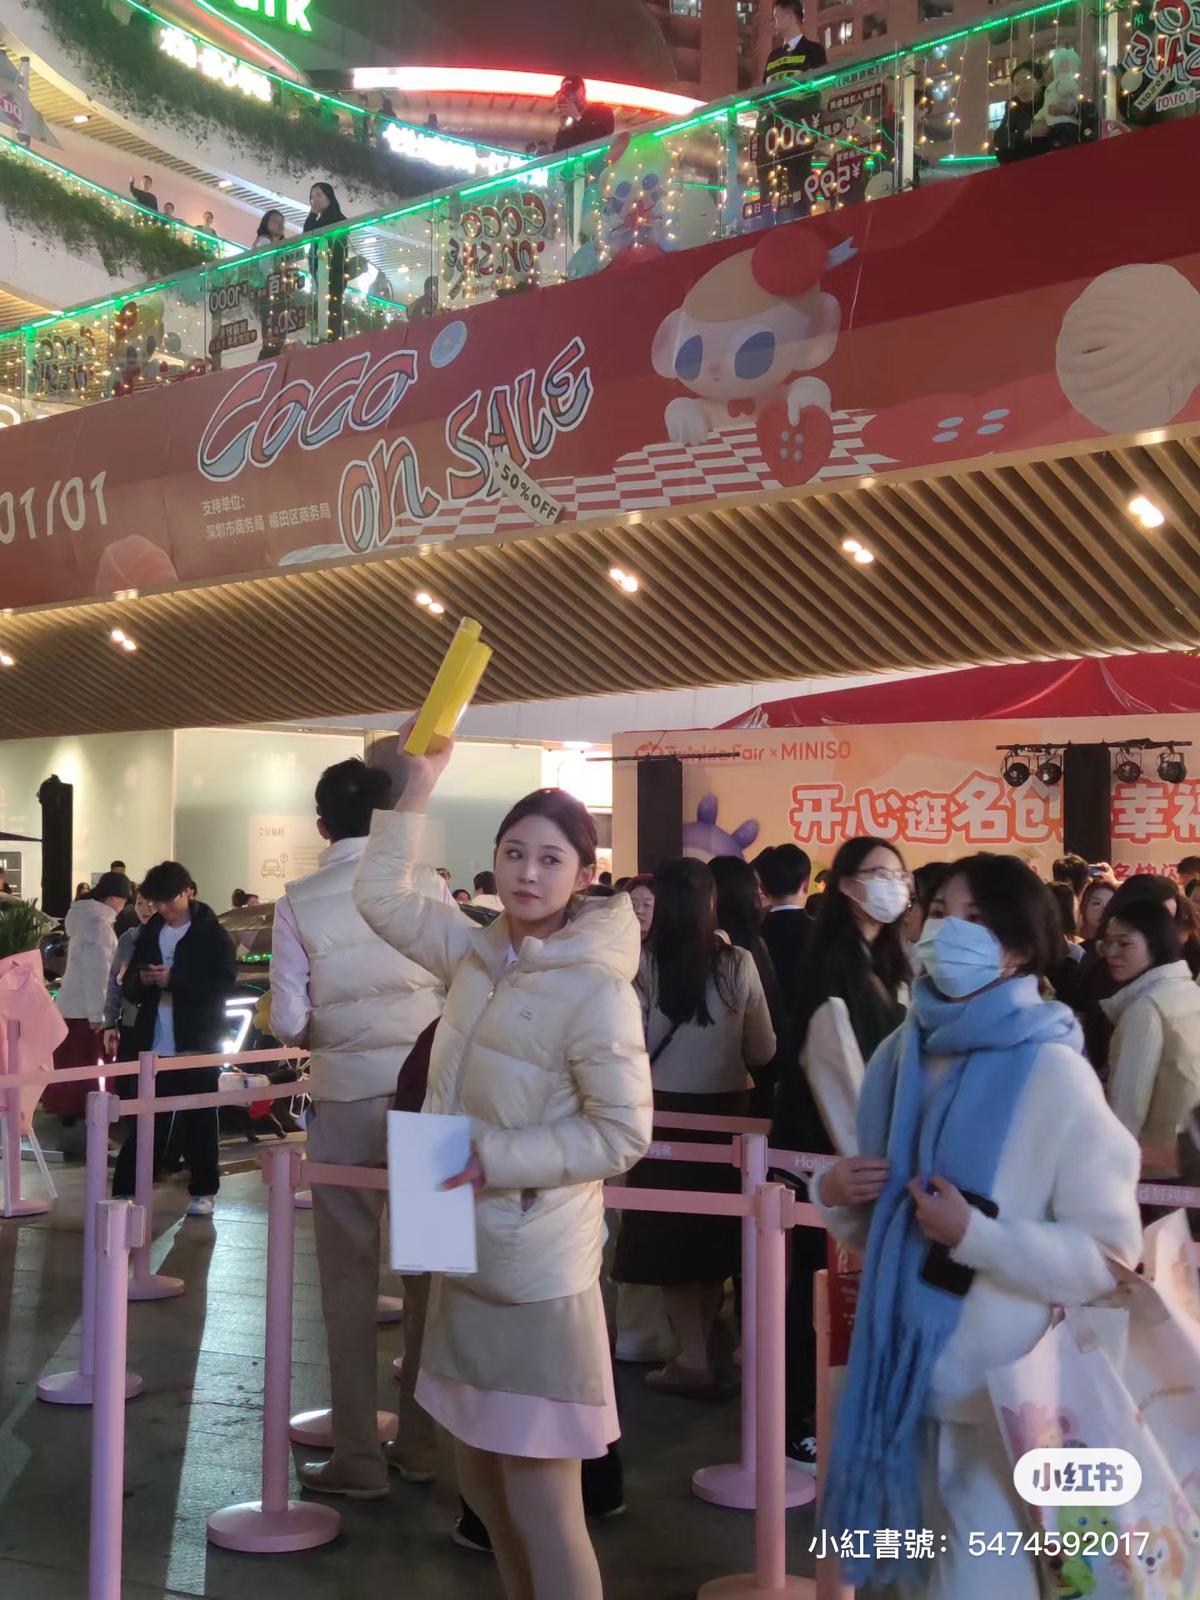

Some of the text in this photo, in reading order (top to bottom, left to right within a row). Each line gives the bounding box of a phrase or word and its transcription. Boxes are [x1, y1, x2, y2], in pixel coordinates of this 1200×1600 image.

[445, 336, 593, 501] SALE
[0, 470, 107, 545] 01/01
[268, 502, 331, 529] 福田区商务局
[500, 464, 557, 519] 50%OFF
[780, 740, 852, 761] MINISO
